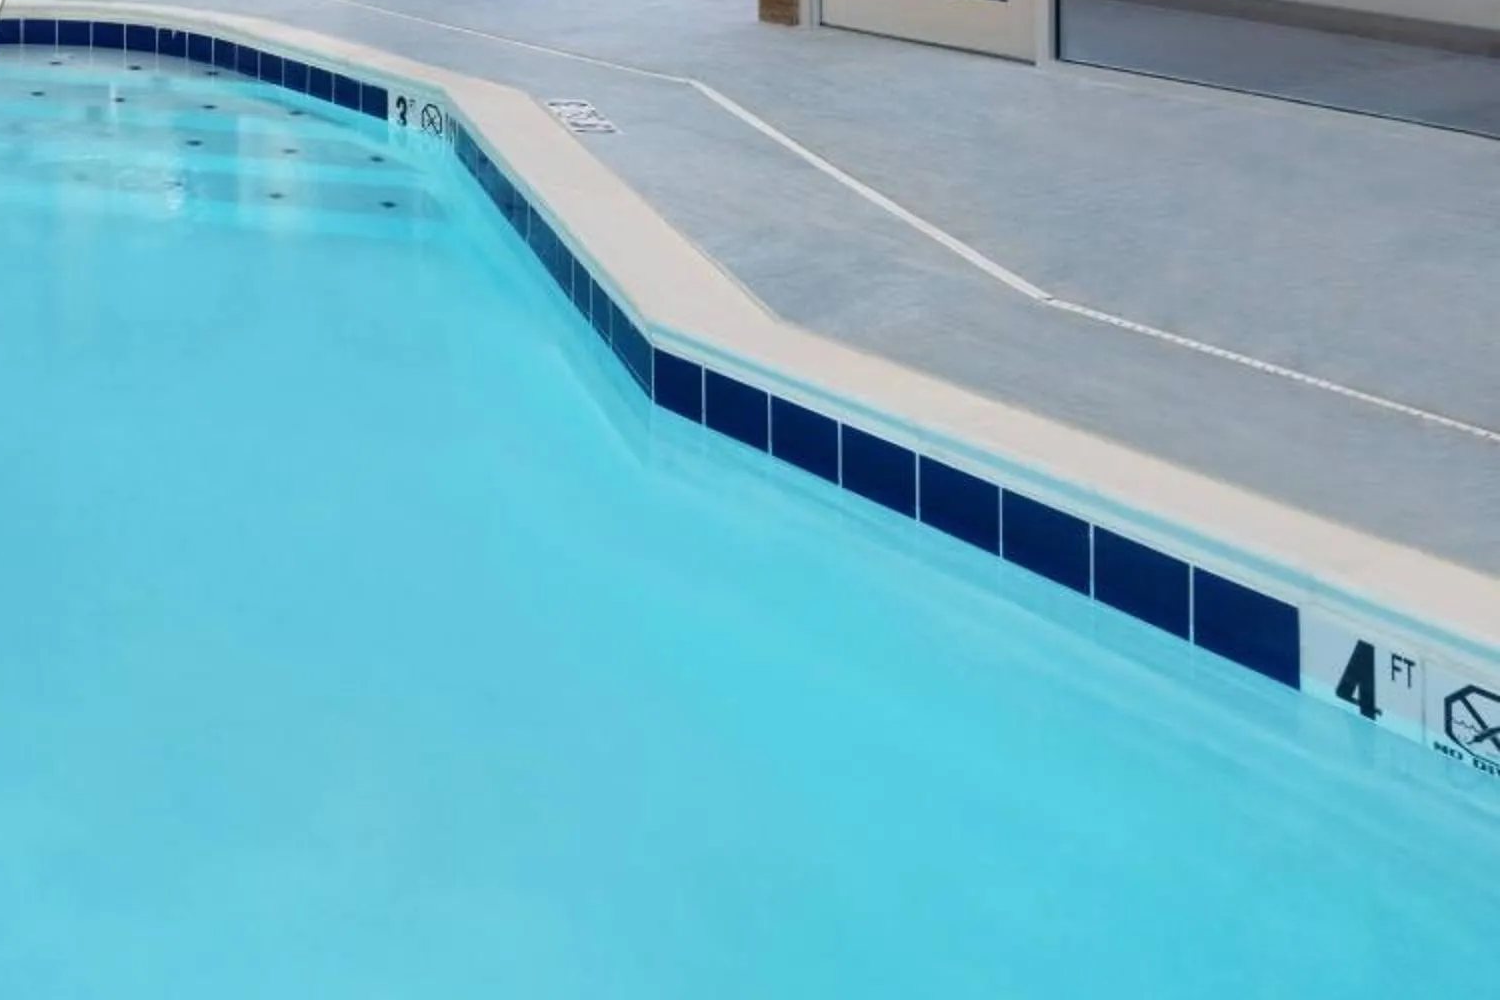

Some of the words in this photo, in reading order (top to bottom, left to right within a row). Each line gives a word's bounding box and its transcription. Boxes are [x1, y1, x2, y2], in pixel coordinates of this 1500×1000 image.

[396, 96, 407, 127] 3
[1335, 638, 1382, 721] 4
[1391, 653, 1416, 689] FT
